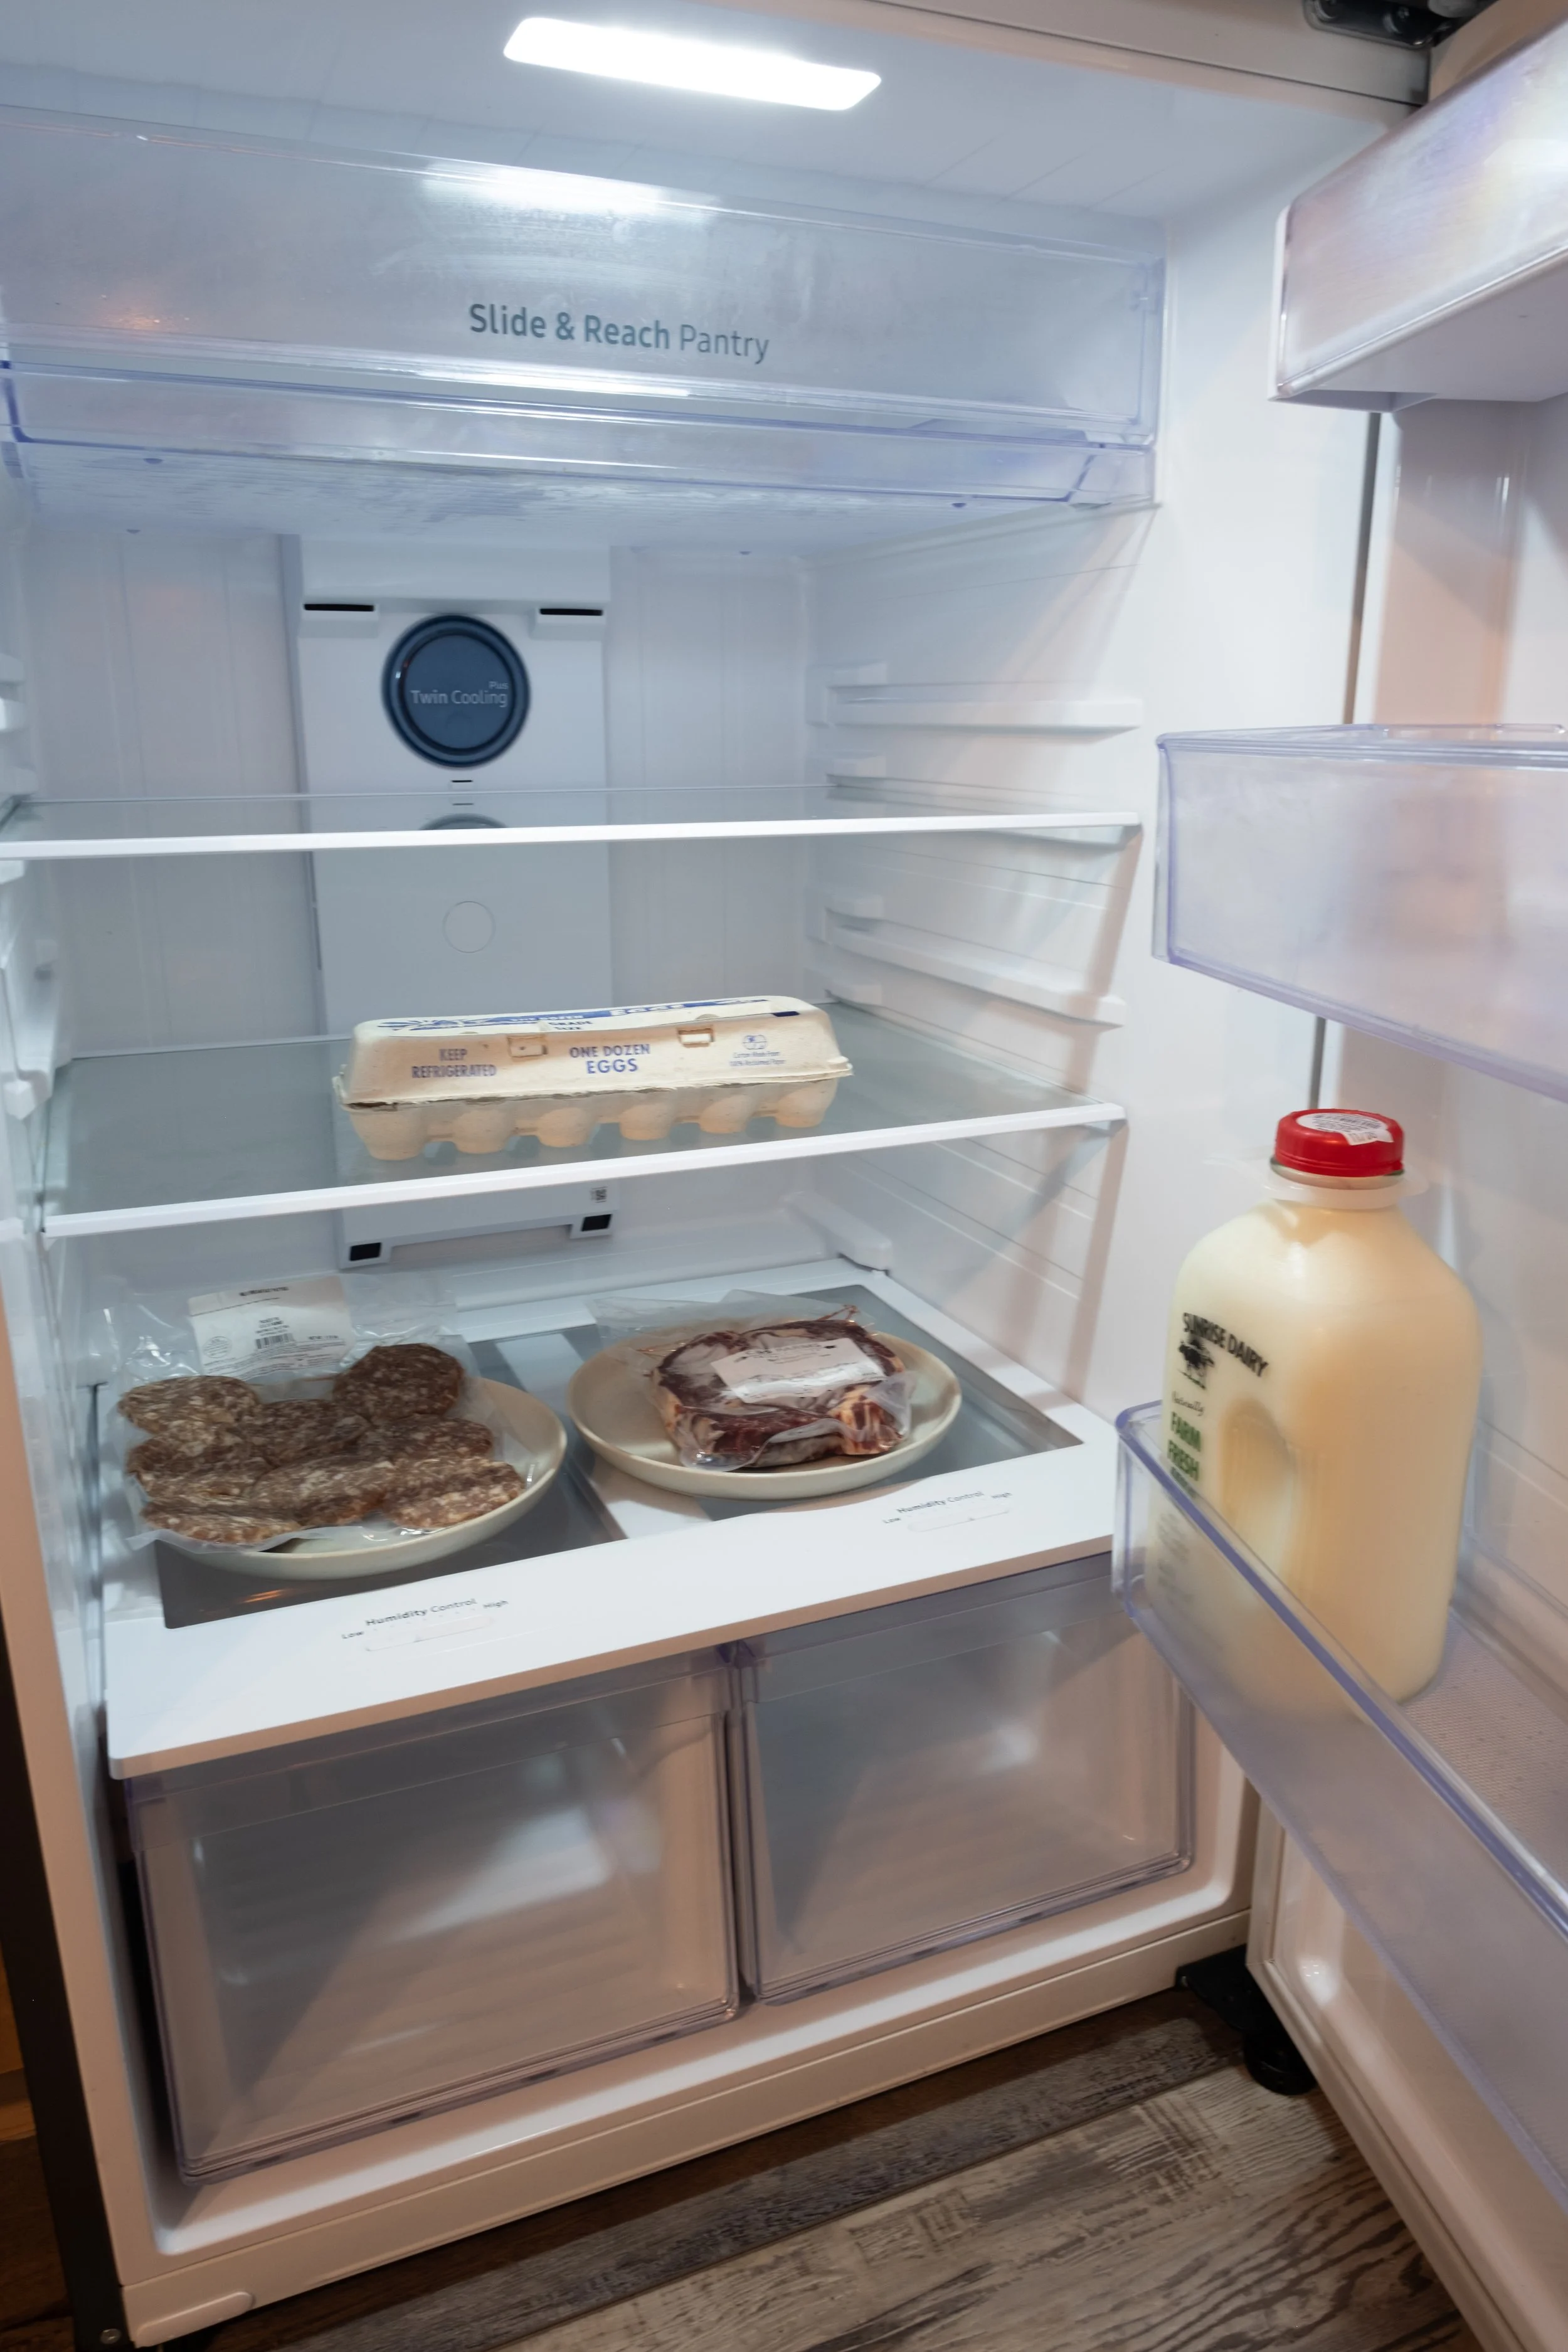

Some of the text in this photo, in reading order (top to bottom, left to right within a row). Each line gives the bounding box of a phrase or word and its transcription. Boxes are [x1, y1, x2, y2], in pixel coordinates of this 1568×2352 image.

[469, 304, 770, 365] Slide & Reach Pantry
[489, 681, 509, 690] Plus
[411, 689, 507, 707] Twin Cooling
[440, 1048, 467, 1061] KEEP
[569, 1044, 650, 1058] ONE DOZEN
[411, 1064, 497, 1078] REFRIGERATED
[586, 1058, 638, 1074] EGGS
[1227, 1333, 1269, 1377] DAIRY
[1167, 1439, 1199, 1481] FRESH
[896, 1491, 984, 1514] Humidity Control
[882, 1517, 901, 1525] Low
[483, 1600, 509, 1609] High
[365, 1599, 477, 1626] Humidity Control
[341, 1631, 365, 1640] Low
